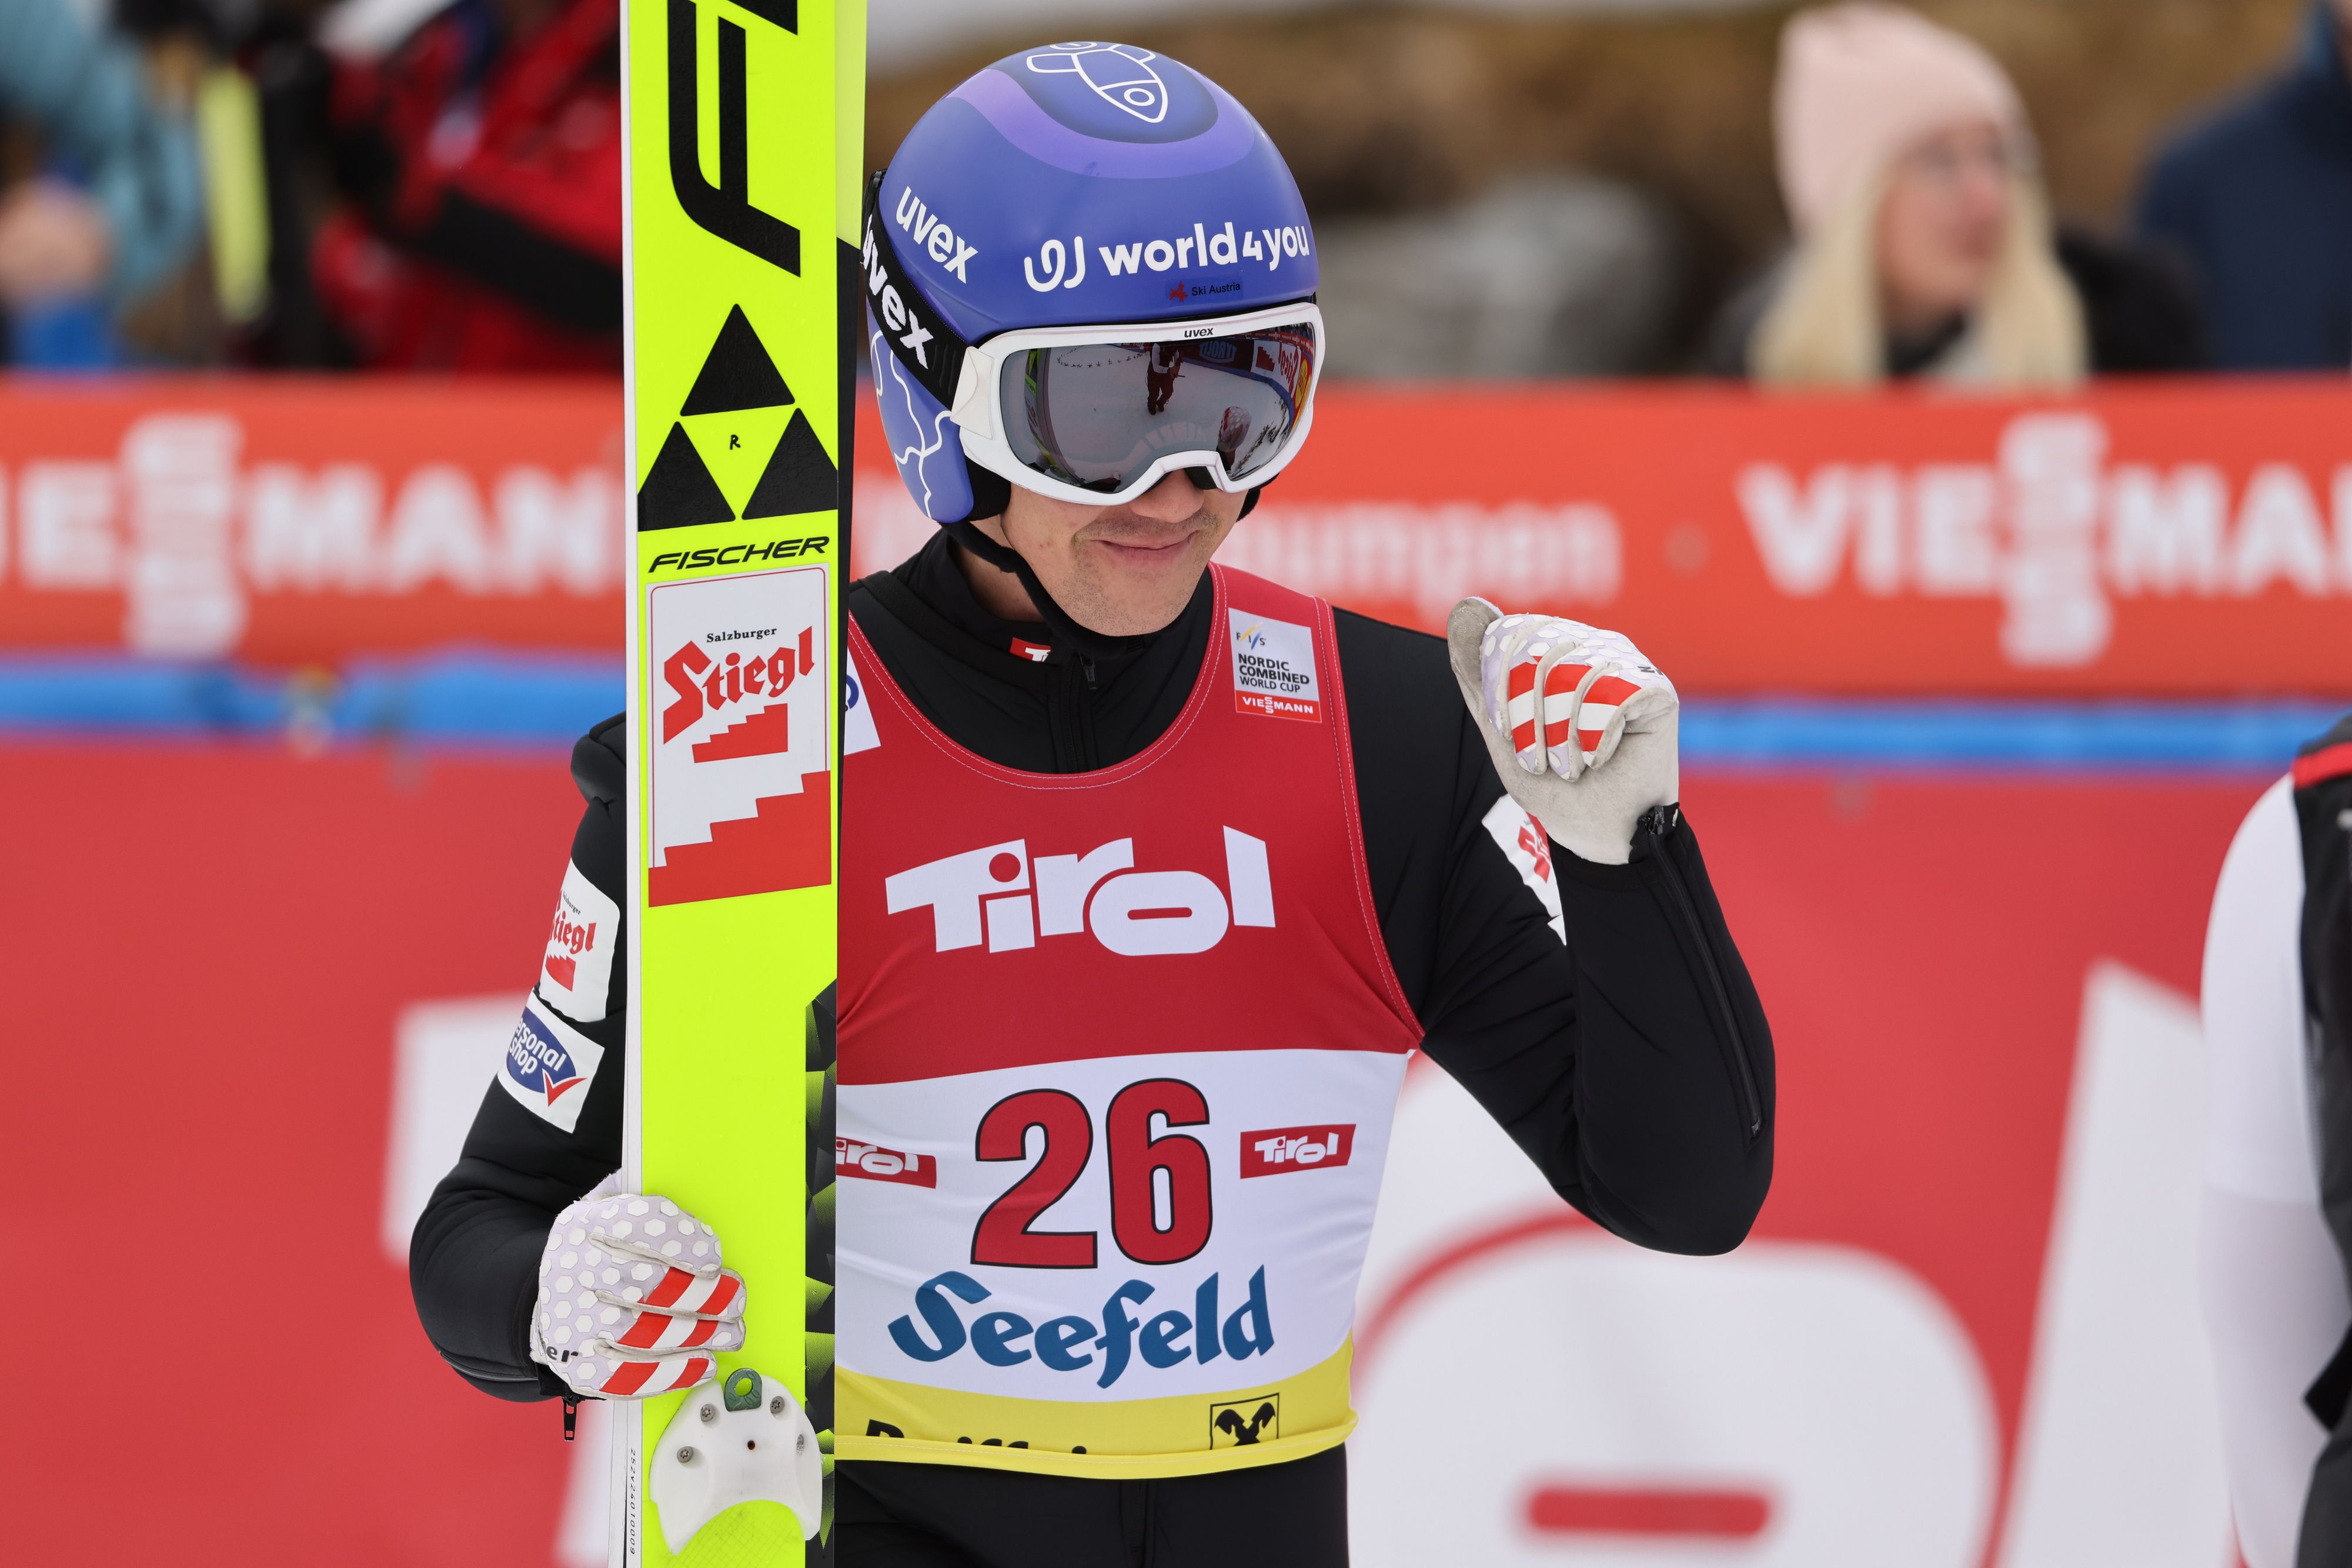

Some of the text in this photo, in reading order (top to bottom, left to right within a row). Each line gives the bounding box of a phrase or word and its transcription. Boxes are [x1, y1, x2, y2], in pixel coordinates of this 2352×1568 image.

[896, 186, 978, 284] uvex
[1098, 222, 1309, 272] world4you
[863, 214, 934, 370] uvex
[1191, 282, 1241, 296] Ski Austria
[1184, 327, 1214, 338] uvex
[730, 434, 741, 450] R
[0, 412, 627, 661] ESSMAN
[648, 536, 830, 573] FISCHER
[1736, 413, 2352, 668] VIESSMA
[706, 626, 777, 643] Salzburger
[1238, 653, 1290, 671] NORDIC
[1240, 665, 1309, 684] COMBINED
[663, 626, 815, 744] Stiegl
[1240, 676, 1301, 693] WORLD CUP
[1242, 696, 1314, 714] VIESSMANN
[885, 825, 1276, 956] Tirol
[509, 1037, 538, 1075] shop
[836, 1139, 918, 1175] irol
[1254, 1132, 1339, 1164] Tirol
[970, 1078, 1213, 1269] 26
[887, 1264, 1275, 1389] Seefeld
